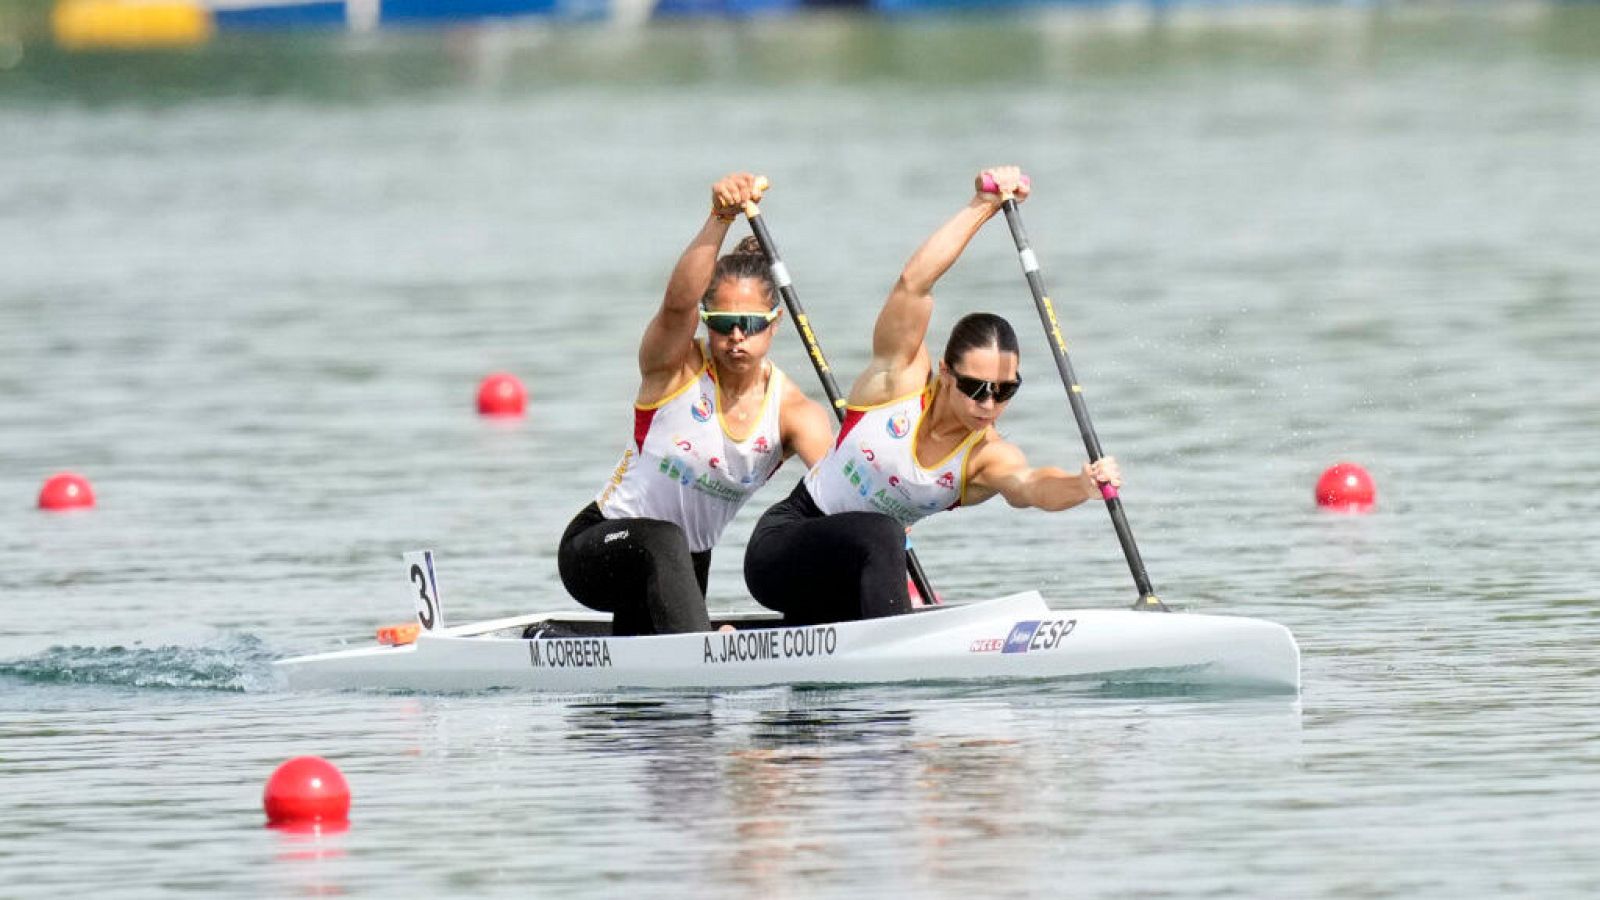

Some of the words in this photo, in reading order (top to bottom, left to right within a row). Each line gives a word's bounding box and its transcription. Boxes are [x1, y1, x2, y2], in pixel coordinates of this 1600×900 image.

[411, 564, 434, 630] 3
[704, 635, 718, 663] A.
[720, 631, 779, 662] JACOME
[783, 627, 836, 657] COUTO
[1029, 620, 1077, 650] ESP
[529, 640, 546, 667] M.
[546, 640, 612, 667] CORBERA
